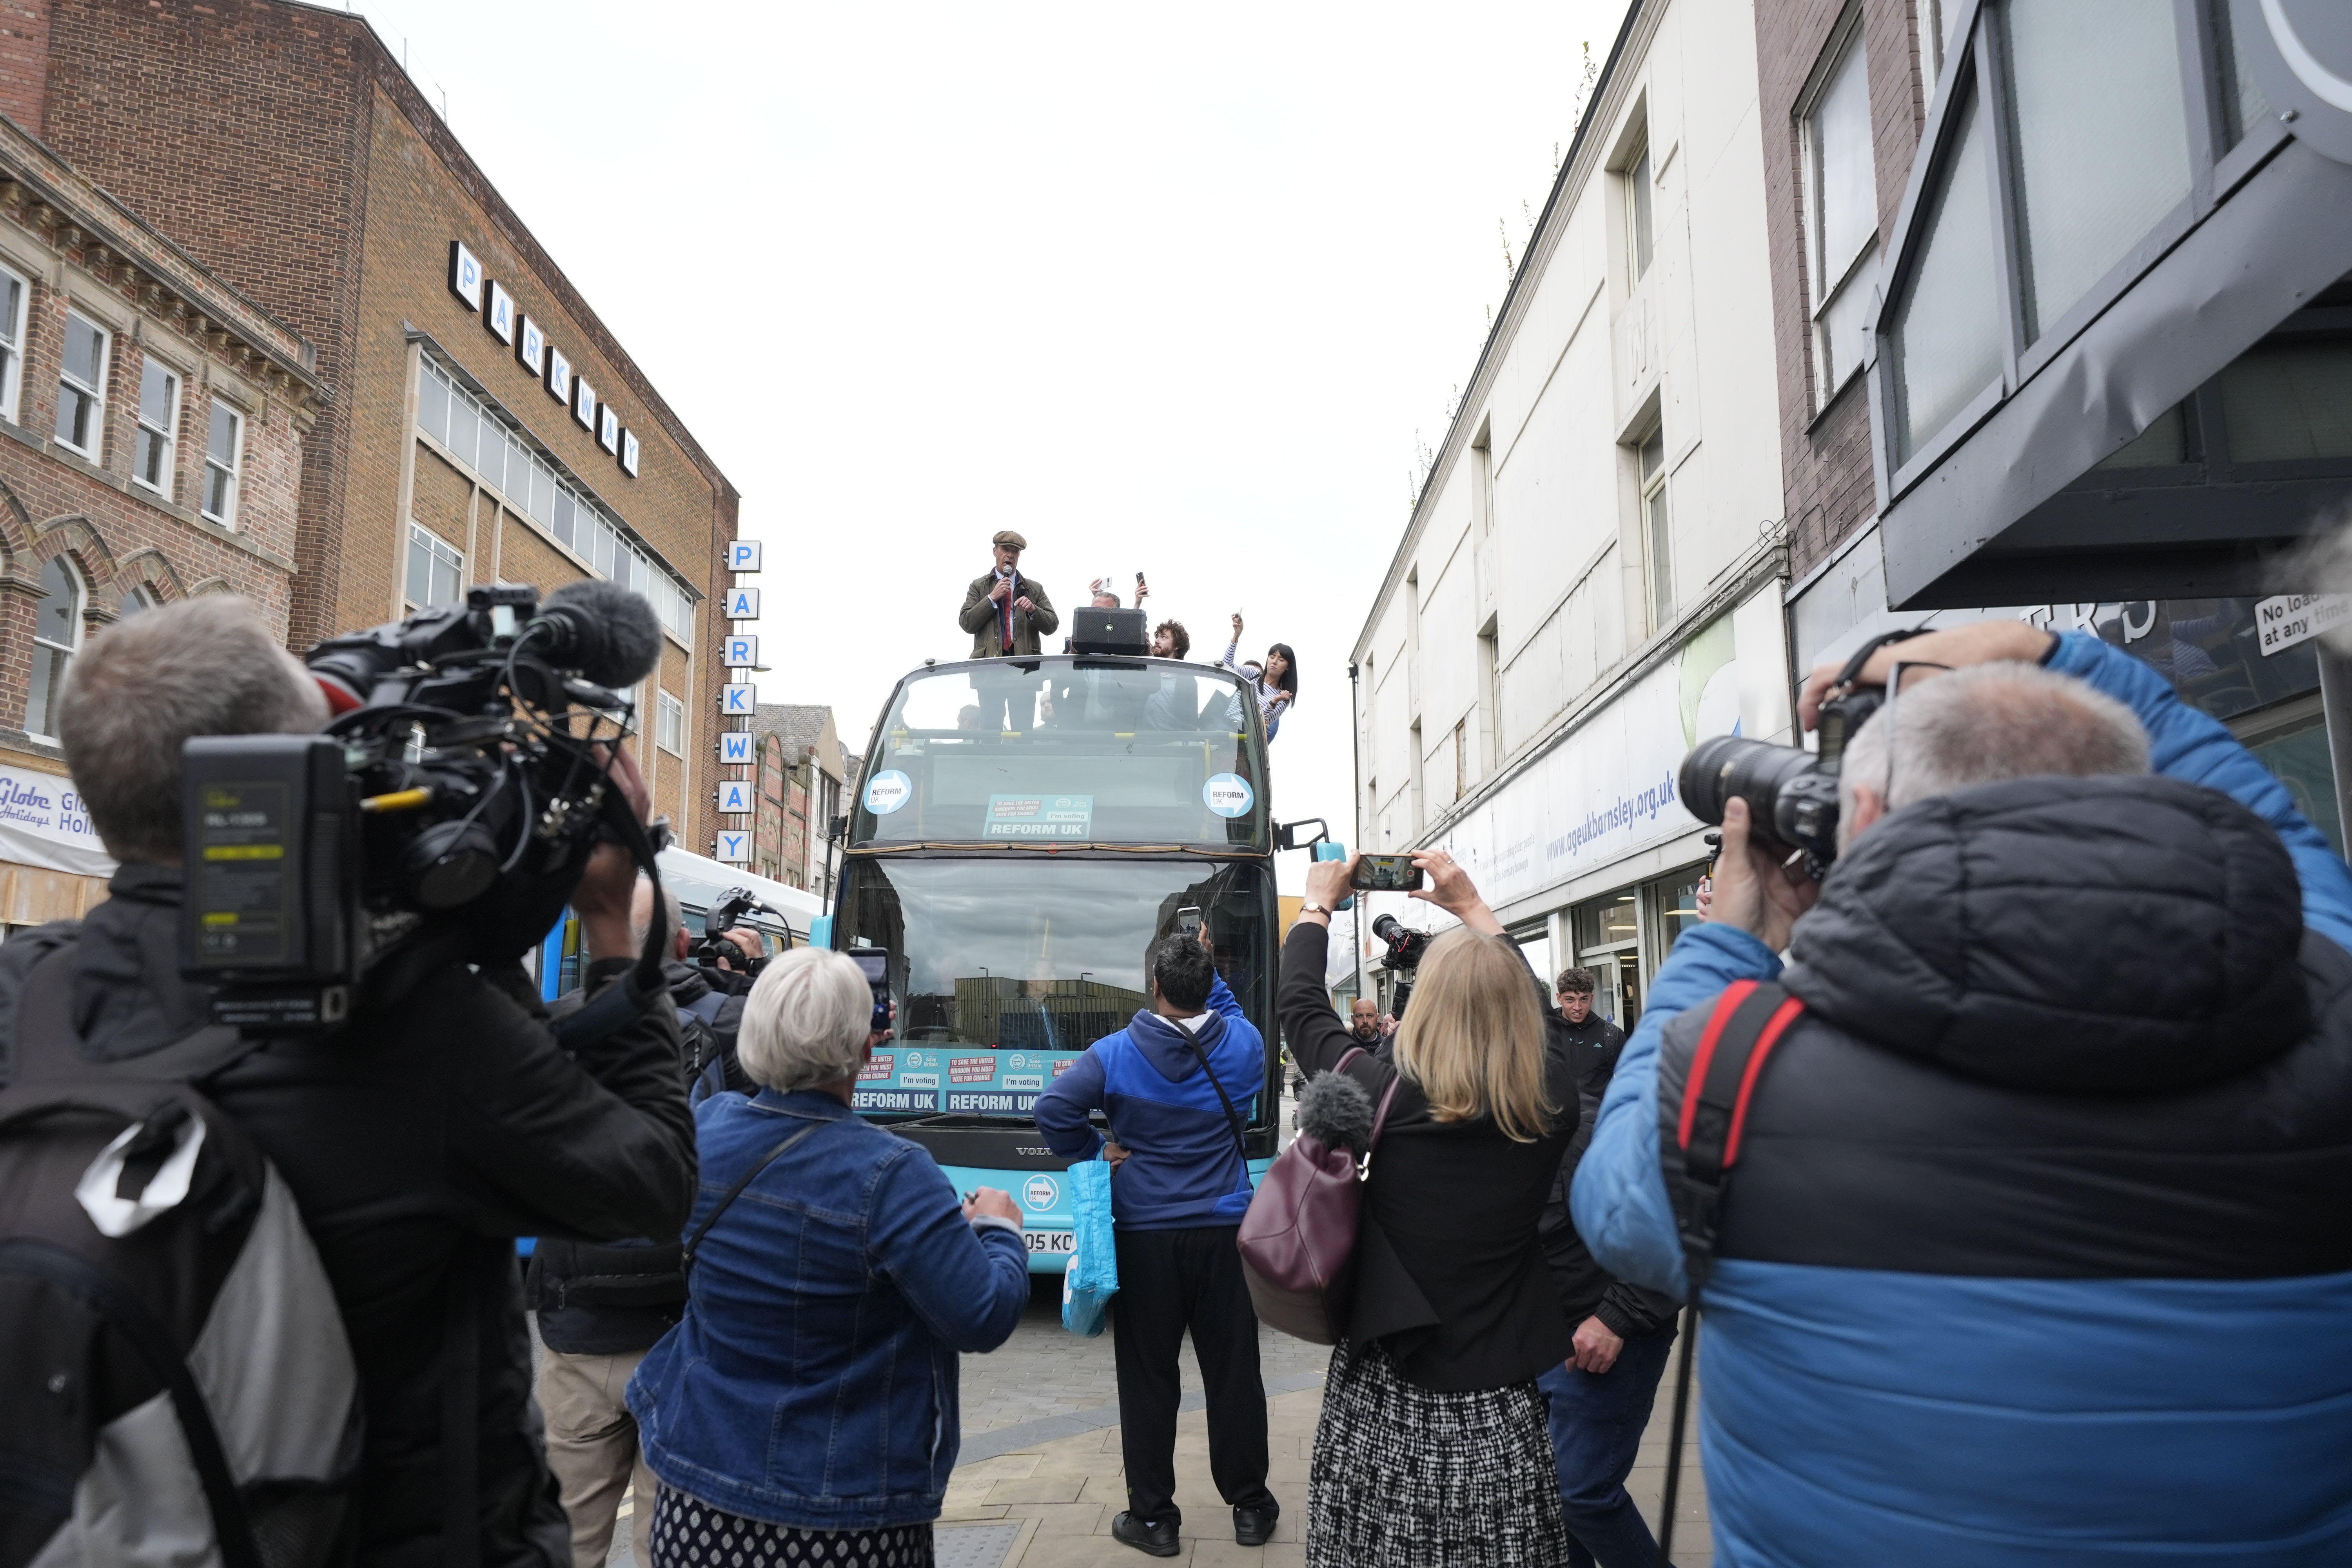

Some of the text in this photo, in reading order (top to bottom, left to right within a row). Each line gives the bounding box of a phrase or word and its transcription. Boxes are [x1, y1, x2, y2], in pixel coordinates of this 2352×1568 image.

[463, 257, 635, 465] PARKWAY
[2262, 605, 2283, 624] No
[2265, 600, 2349, 646] at any time
[724, 546, 751, 857] PARKWAY
[0, 778, 51, 809] Globe
[0, 805, 50, 827] Holidays
[1546, 770, 1675, 862] www.ageukbarnsley.org.uk
[991, 824, 1082, 834] REFORM UK
[1499, 845, 1514, 864] supporting
[1515, 840, 1523, 854] older
[1523, 832, 1535, 853] people
[1502, 864, 1515, 880] Barnsley
[1515, 856, 1529, 873] borough
[1019, 1078, 1039, 1087] voting
[851, 1093, 934, 1109] REFORM UK
[950, 1094, 1038, 1111] REFORM UK
